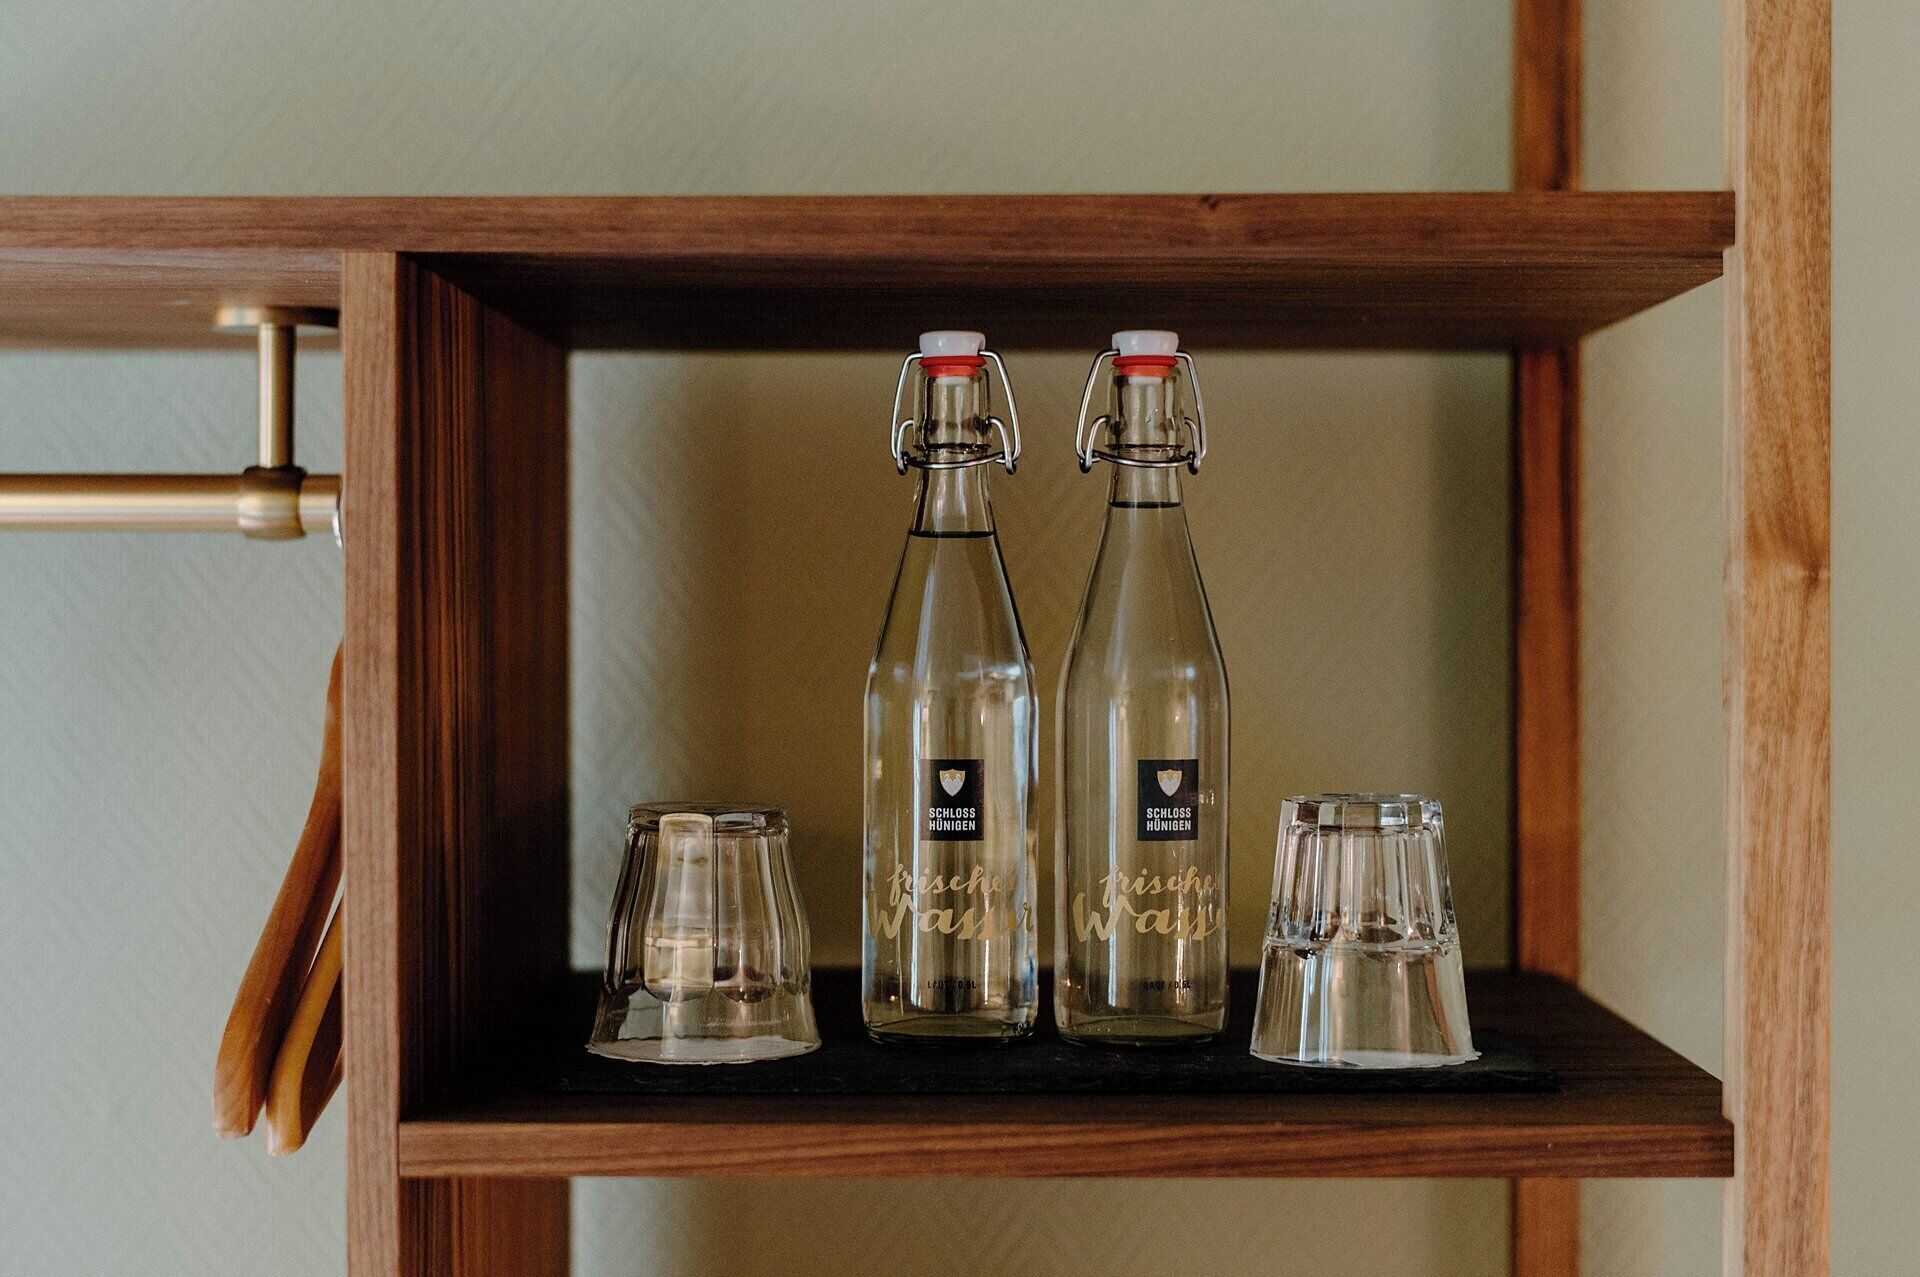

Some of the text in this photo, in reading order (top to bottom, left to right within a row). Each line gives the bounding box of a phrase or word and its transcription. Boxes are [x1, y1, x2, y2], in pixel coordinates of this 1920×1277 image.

[929, 807, 976, 819] SCHLOSS
[1146, 807, 1191, 819] SCHLOSS
[929, 819, 976, 831] HÜNIGEN
[1146, 819, 1191, 831] HÜNIGEN
